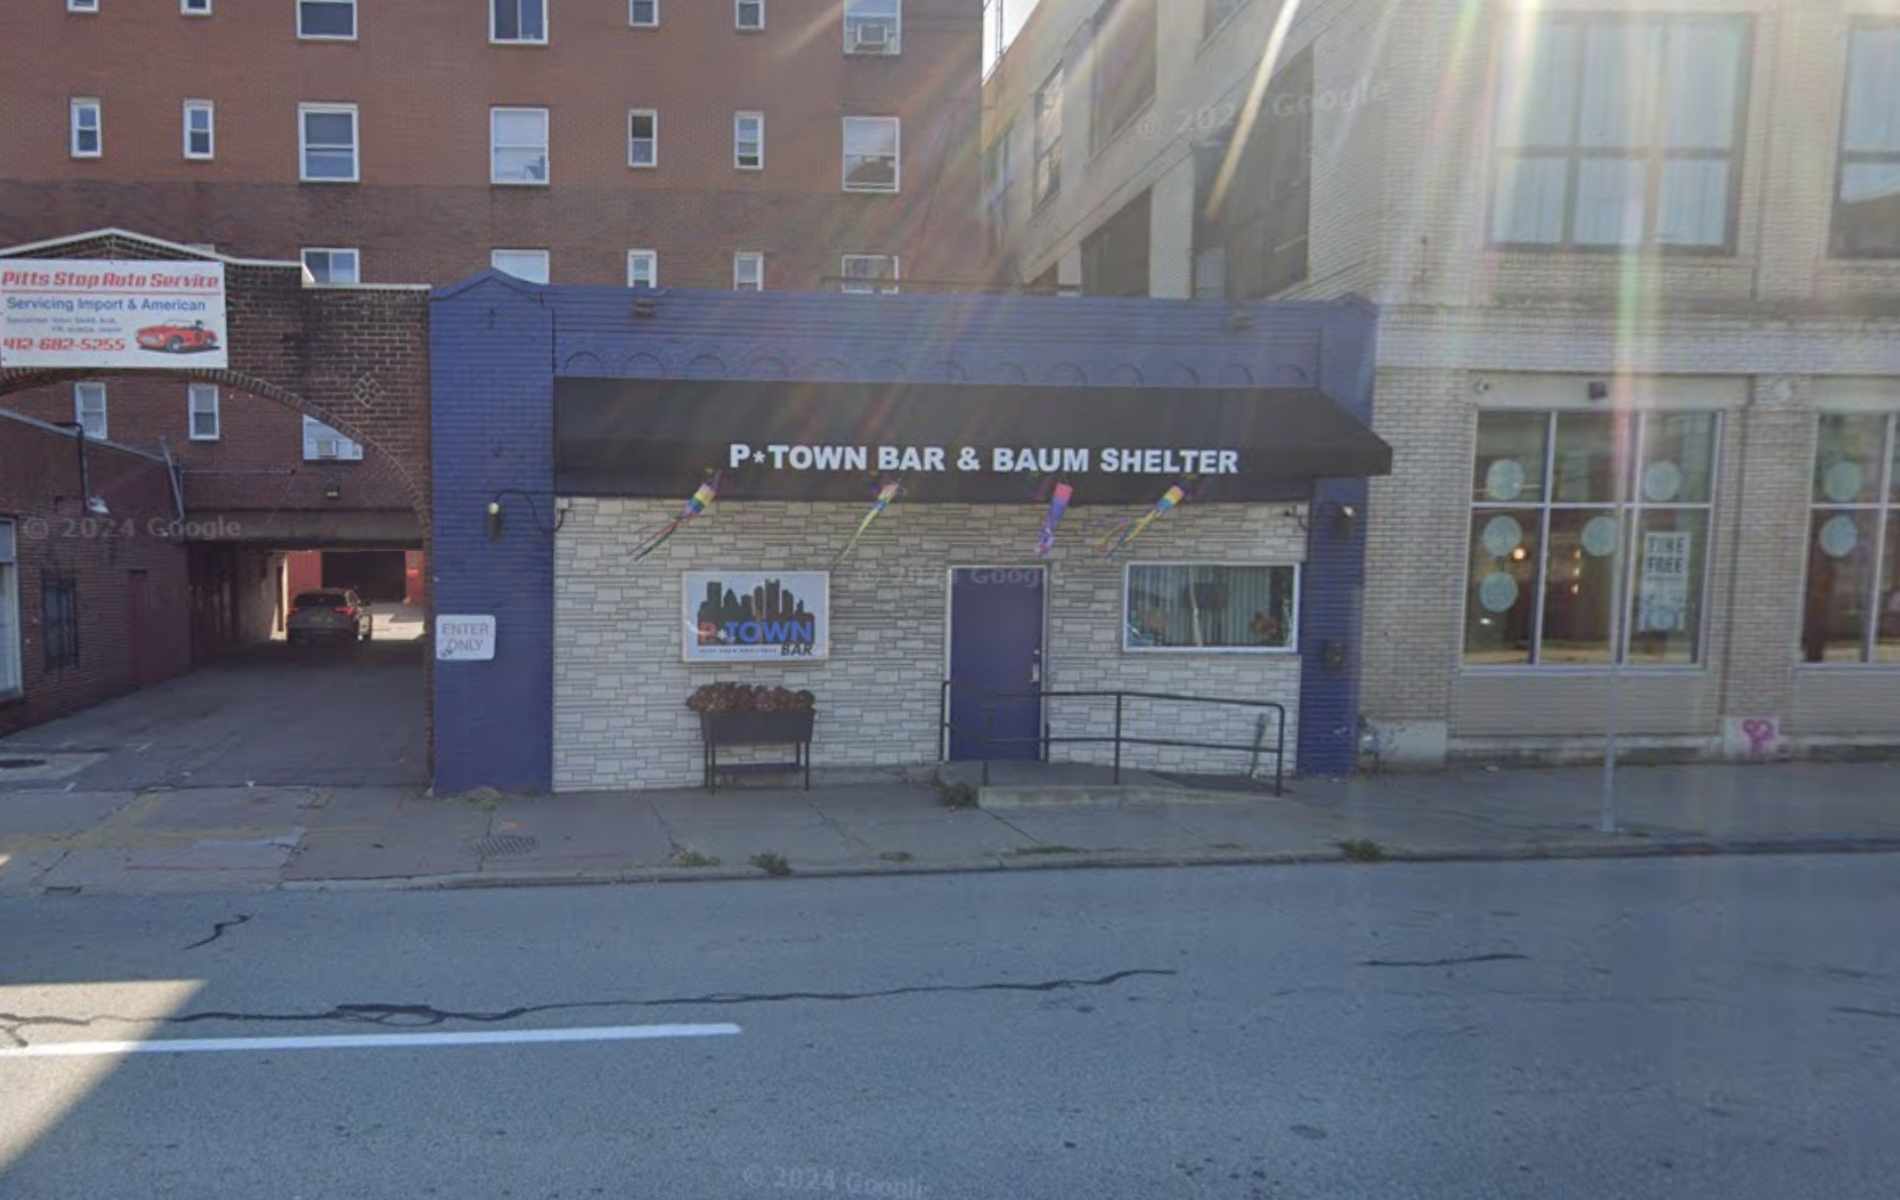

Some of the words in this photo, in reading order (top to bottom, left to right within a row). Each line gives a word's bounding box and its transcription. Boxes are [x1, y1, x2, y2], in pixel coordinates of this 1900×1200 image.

[2, 271, 48, 287] Pitts
[53, 272, 100, 289] Stop
[150, 273, 219, 288] Service
[6, 297, 74, 312] Servicing
[78, 298, 123, 312] Import
[127, 299, 137, 310] &
[141, 299, 206, 311] American
[878, 446, 945, 471] BAR
[956, 447, 981, 471] &
[992, 448, 1089, 472] BAUM
[1100, 448, 1239, 473] SHELTER
[442, 623, 489, 635] ENTER
[448, 638, 484, 651] ONLY
